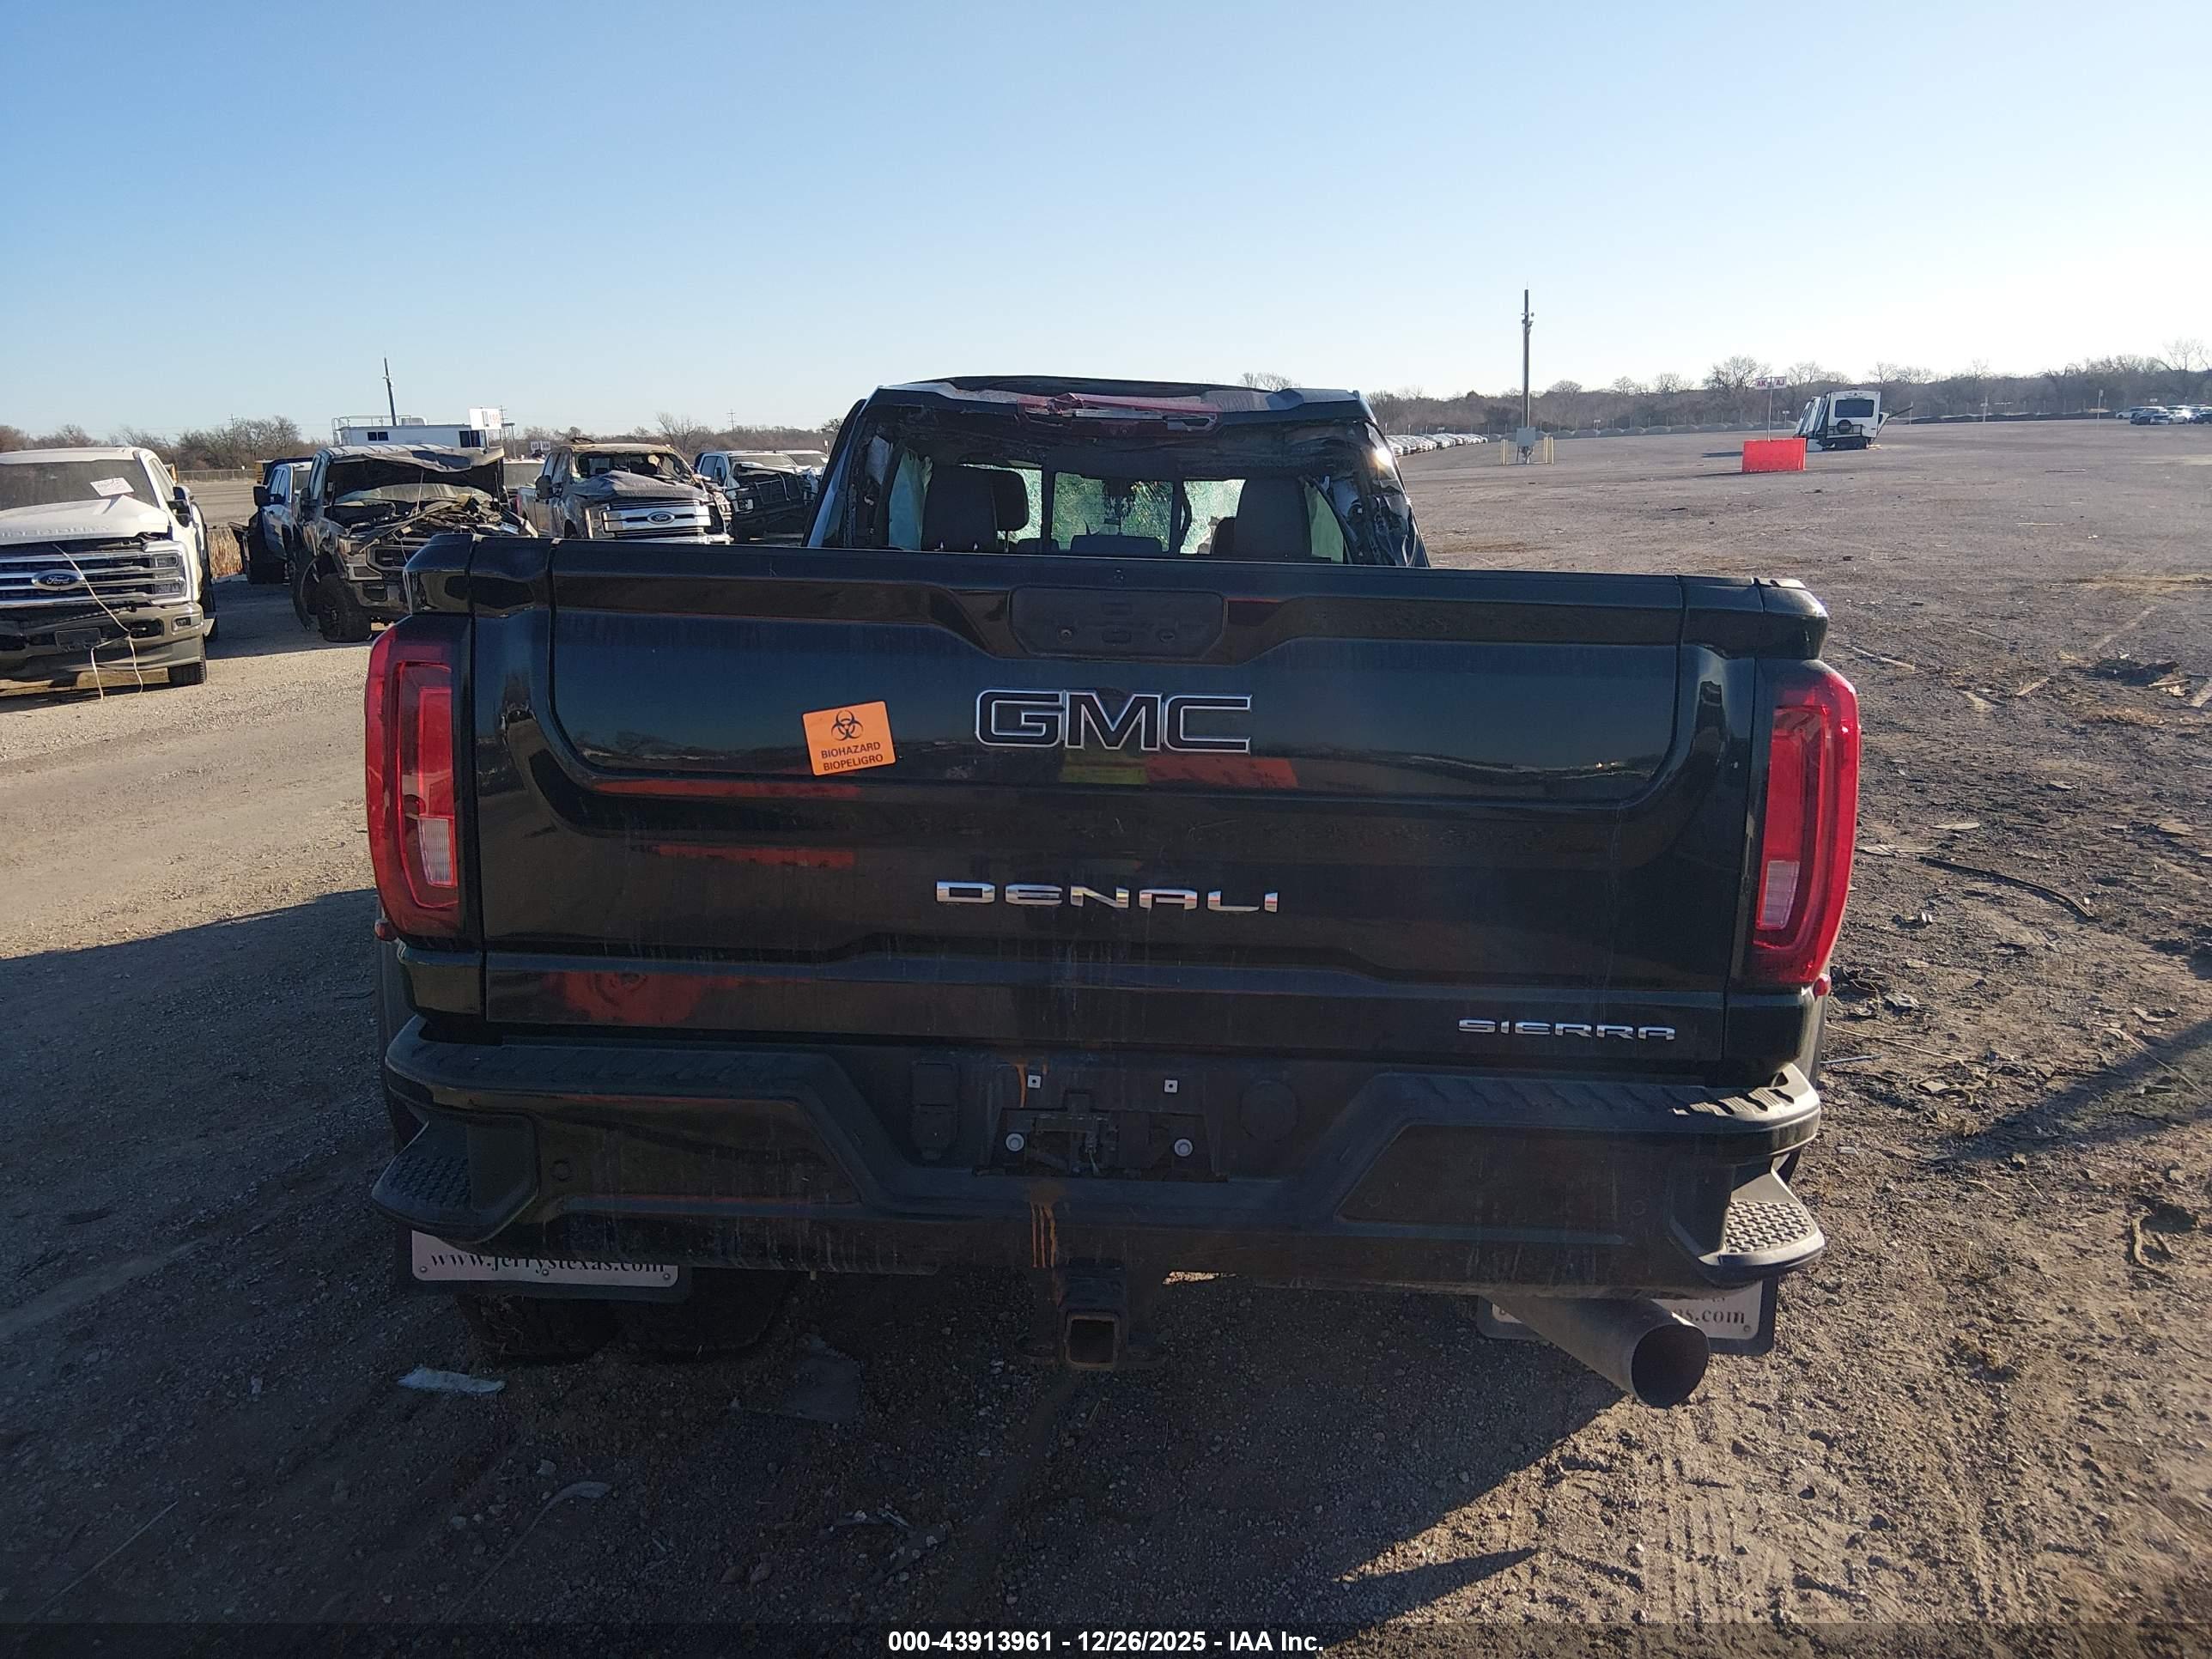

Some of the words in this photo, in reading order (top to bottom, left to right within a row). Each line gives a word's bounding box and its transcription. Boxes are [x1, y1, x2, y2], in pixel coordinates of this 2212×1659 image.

[975, 689, 1252, 754] GMC
[821, 741, 881, 759] BIOHAZARD
[823, 754, 884, 771] BIOPELIGRO
[936, 880, 1279, 914] DENALI
[1458, 1019, 1675, 1041] SIERRA
